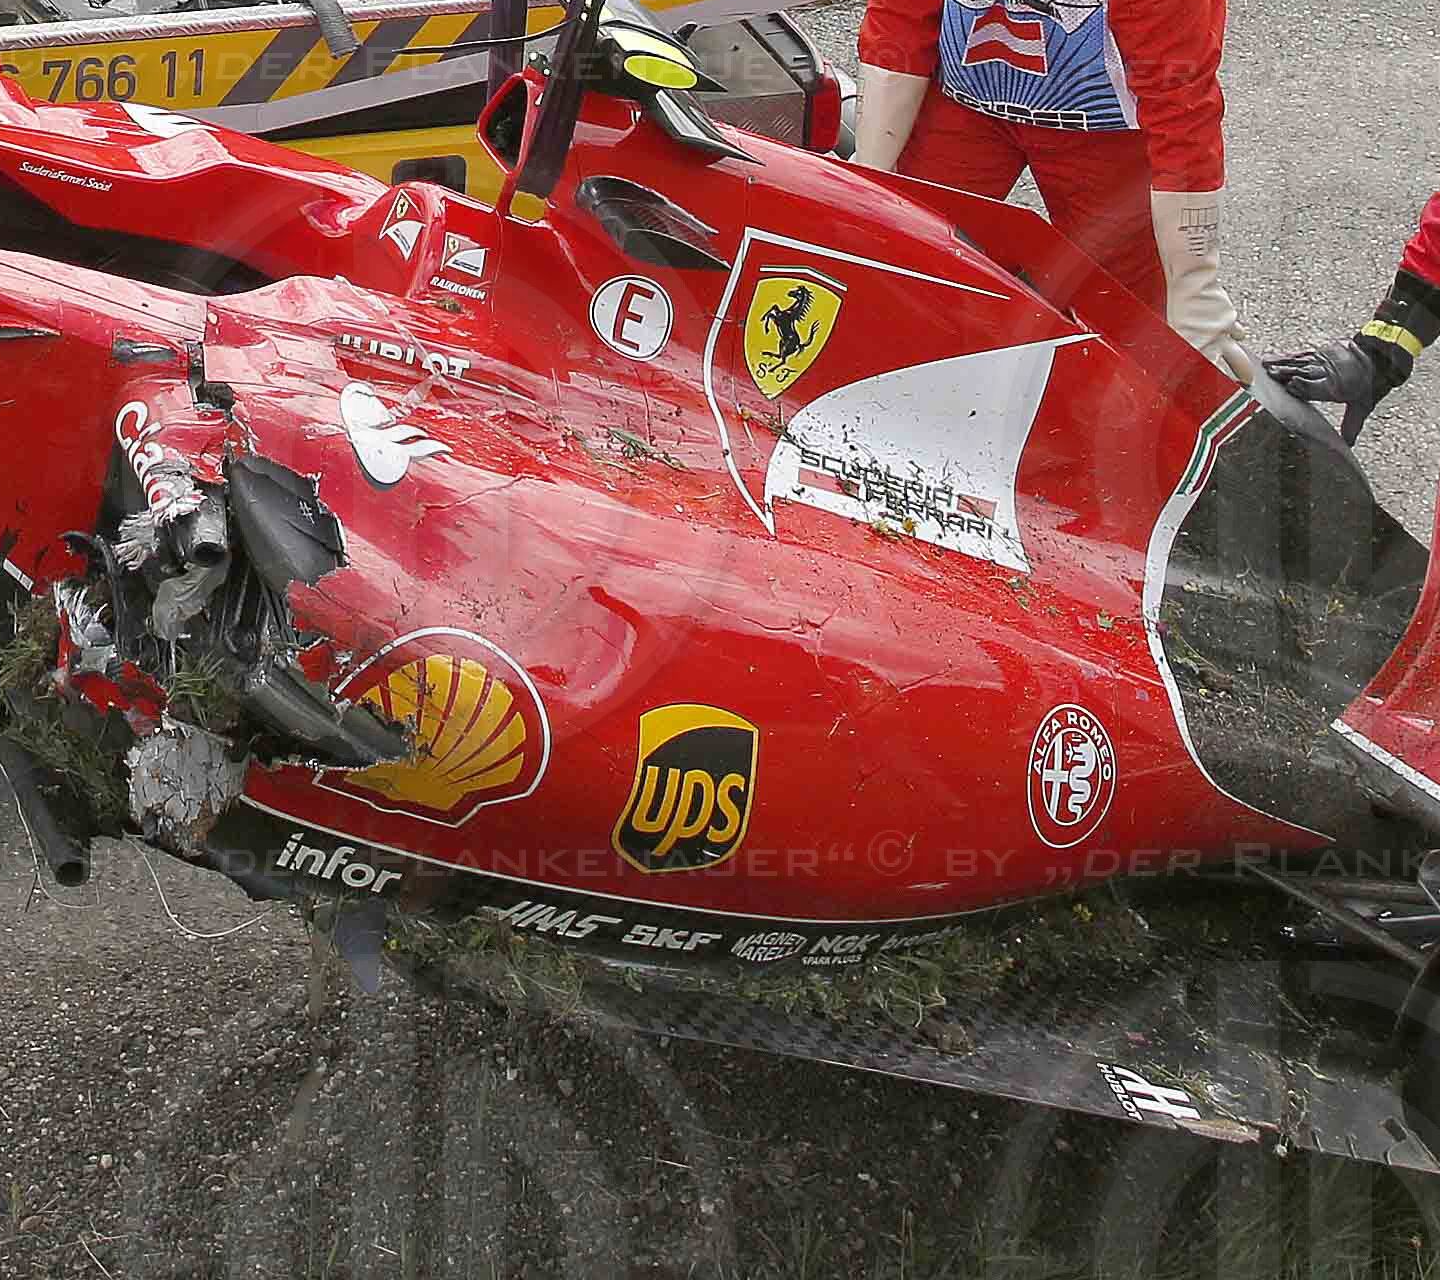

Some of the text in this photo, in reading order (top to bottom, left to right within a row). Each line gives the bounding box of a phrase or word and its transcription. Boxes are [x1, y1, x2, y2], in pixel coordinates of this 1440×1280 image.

[41, 54, 138, 104] 766
[160, 48, 207, 98] 11
[612, 282, 655, 352] E
[1033, 710, 1113, 783] ALFA ROMEO
[275, 832, 402, 893] infor
[622, 924, 722, 951] SKF
[810, 934, 880, 954] NGK
[1096, 1061, 1143, 1121] HUBLOT
